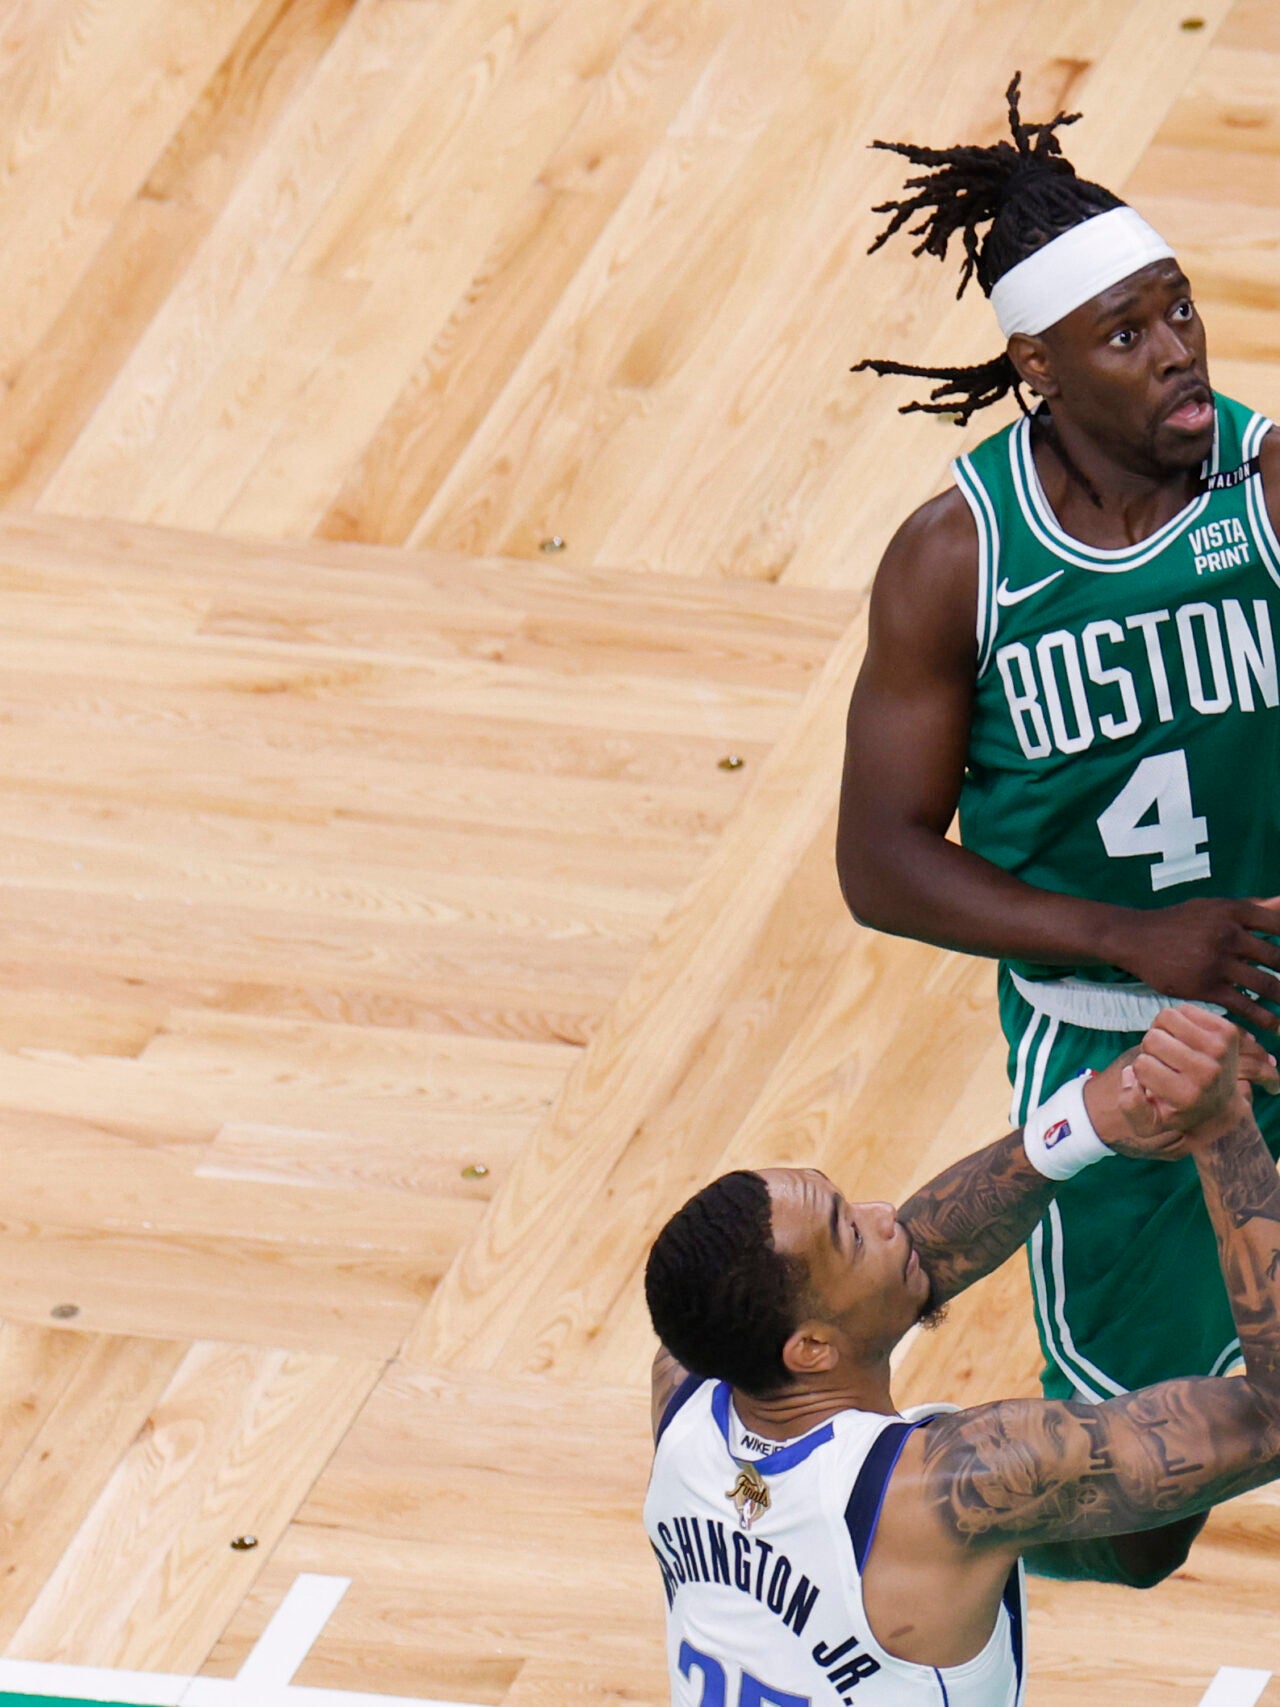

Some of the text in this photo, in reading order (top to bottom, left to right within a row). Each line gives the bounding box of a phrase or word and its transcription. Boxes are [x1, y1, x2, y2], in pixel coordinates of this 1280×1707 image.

[1207, 462, 1251, 490] WALTON
[1188, 517, 1248, 556] VISTA
[1194, 542, 1251, 576] PRINT
[996, 599, 1280, 760] BOSTON
[1097, 748, 1211, 892] 4
[740, 1434, 772, 1457] NIKE
[649, 1516, 820, 1638] ASHINGTON
[812, 1635, 881, 1707] JR.
